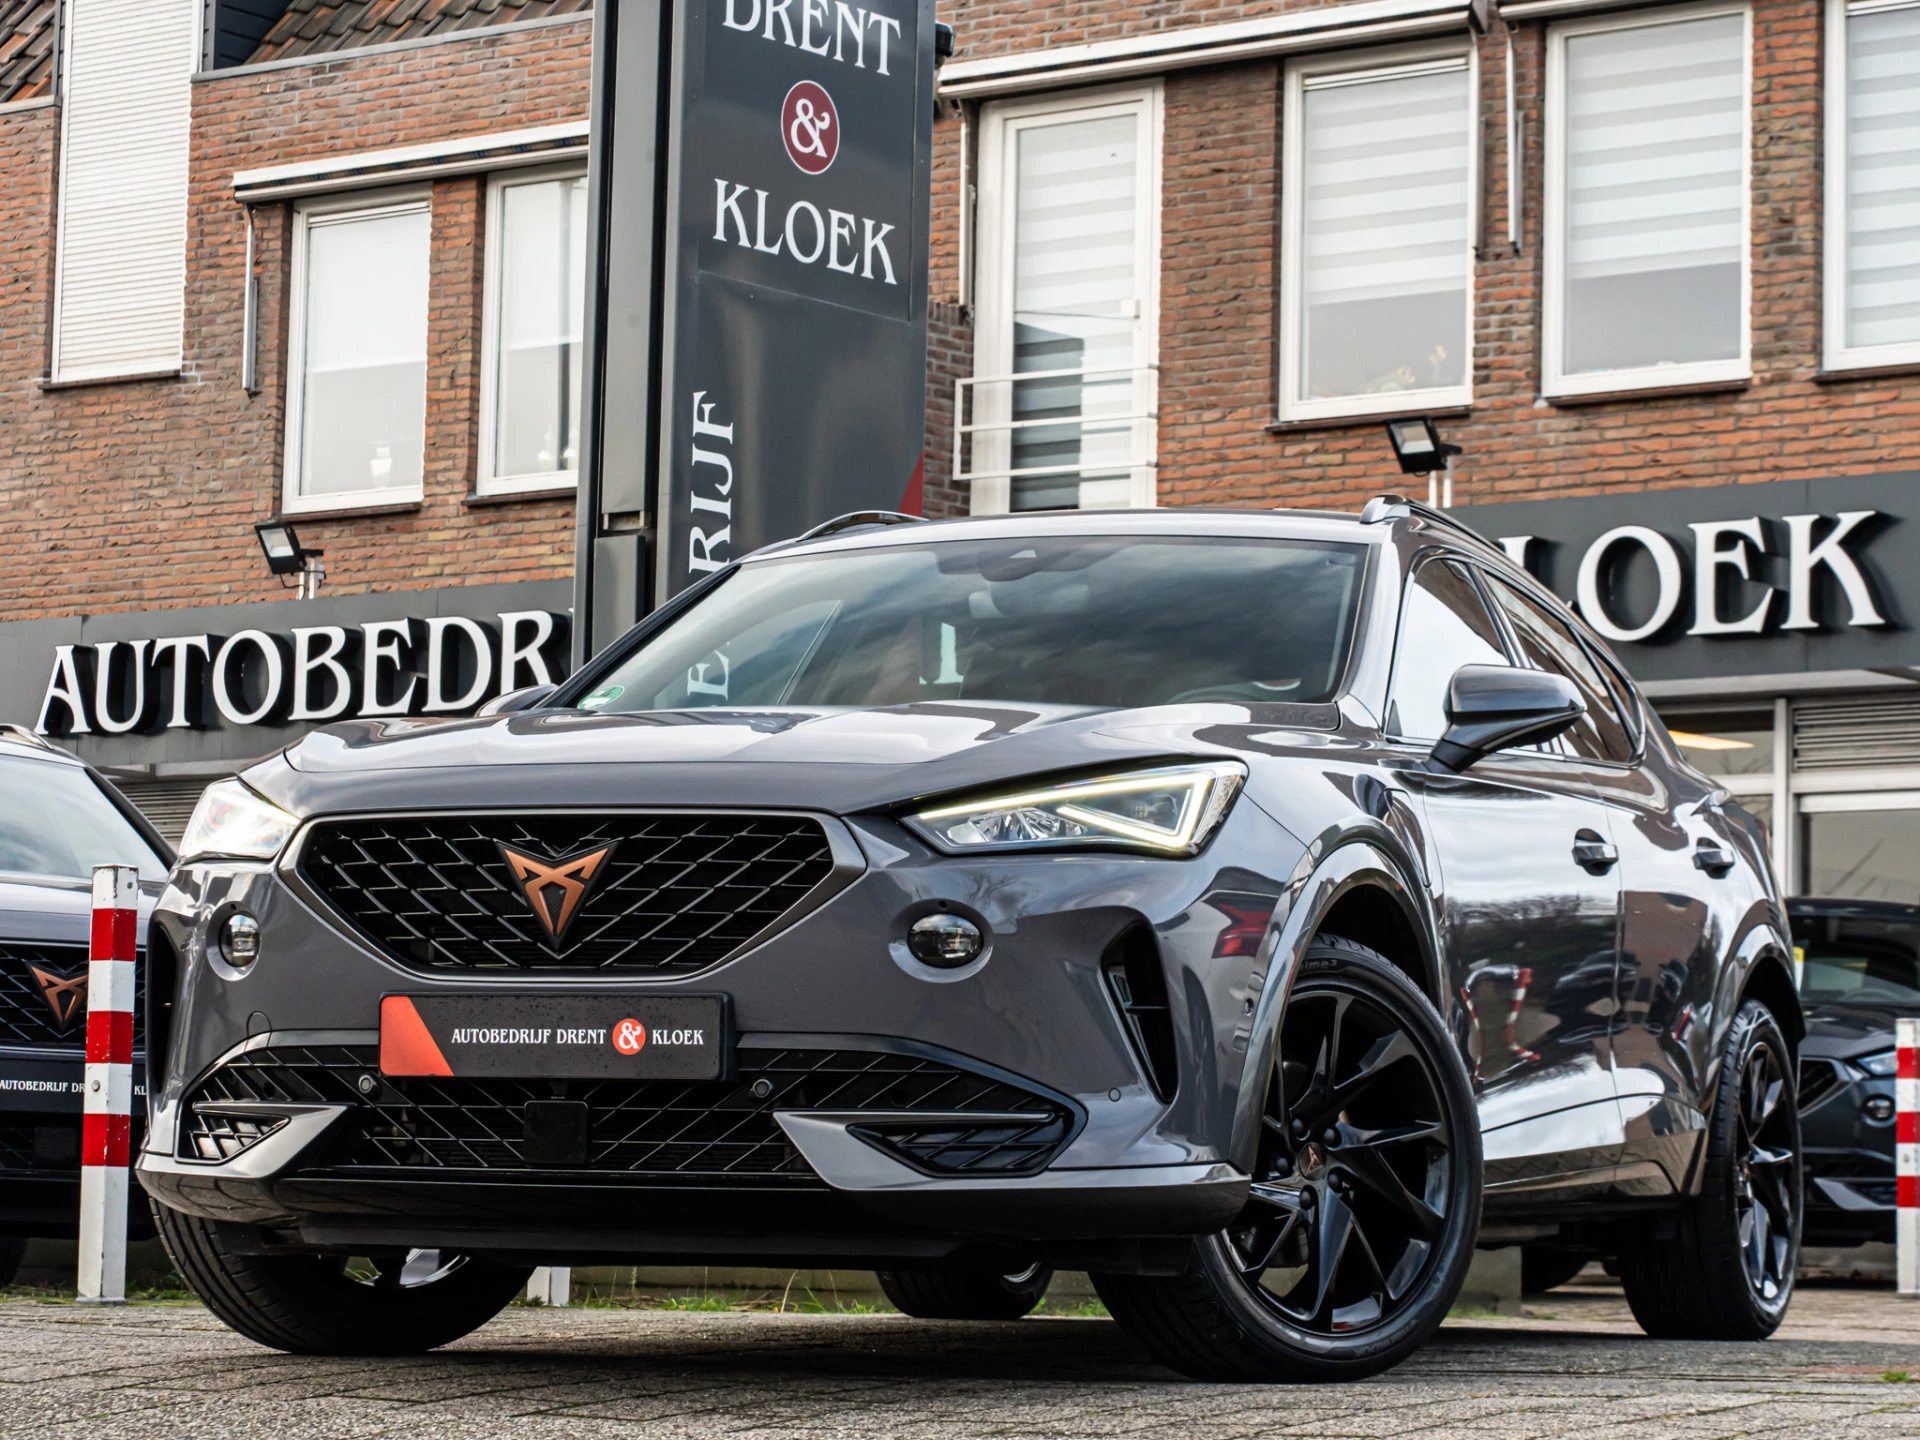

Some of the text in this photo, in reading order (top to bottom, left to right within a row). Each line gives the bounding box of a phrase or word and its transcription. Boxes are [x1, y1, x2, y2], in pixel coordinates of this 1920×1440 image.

[791, 99, 830, 158] &
[712, 178, 898, 285] KLOEK
[1496, 510, 1886, 641] OEK
[34, 606, 574, 736] AUTOBEDR
[451, 1021, 704, 1050] AUTOBEDRIJF DRENT & KLOEK
[71, 1082, 85, 1093] DR
[134, 1085, 147, 1096] KL
